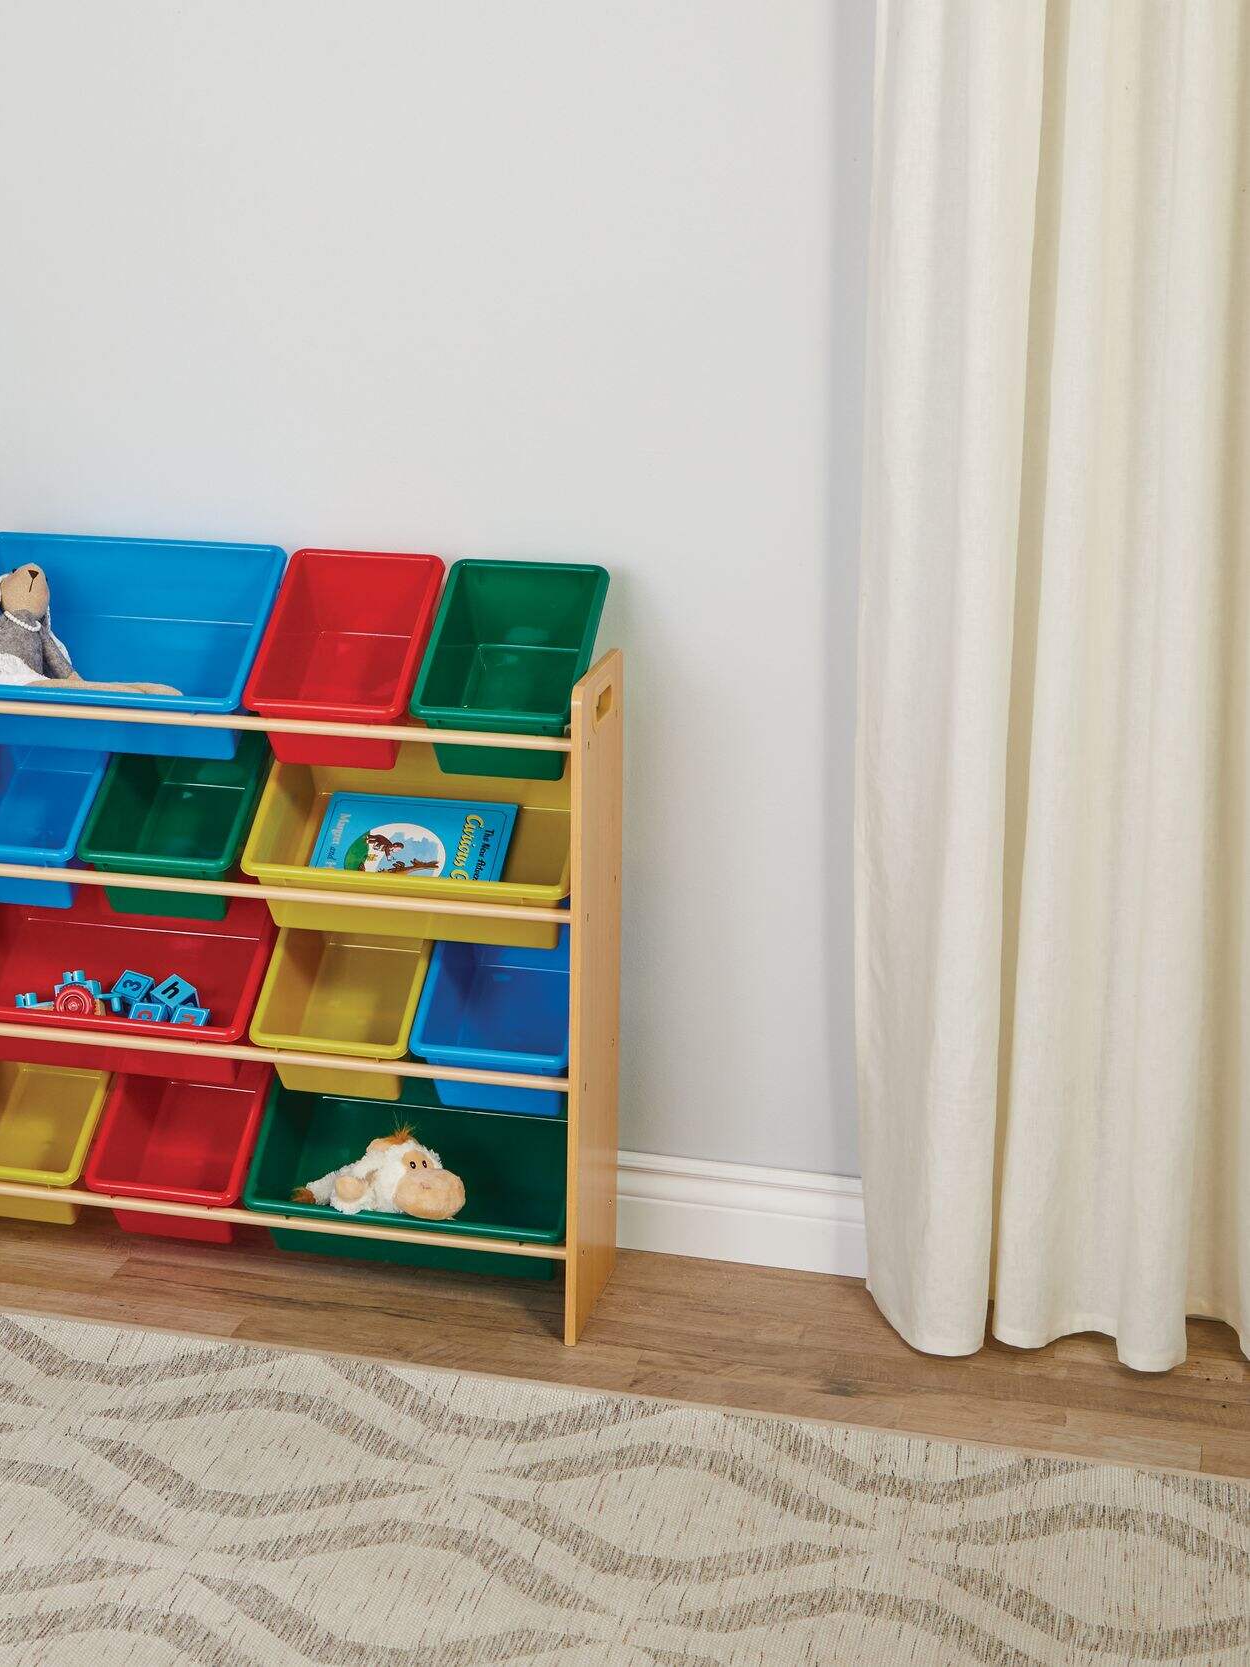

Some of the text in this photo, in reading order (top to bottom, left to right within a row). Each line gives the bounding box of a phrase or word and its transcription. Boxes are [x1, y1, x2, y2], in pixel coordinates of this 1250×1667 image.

[453, 814, 485, 868] Curious
[482, 829, 495, 842] The
[122, 979, 143, 992] 3
